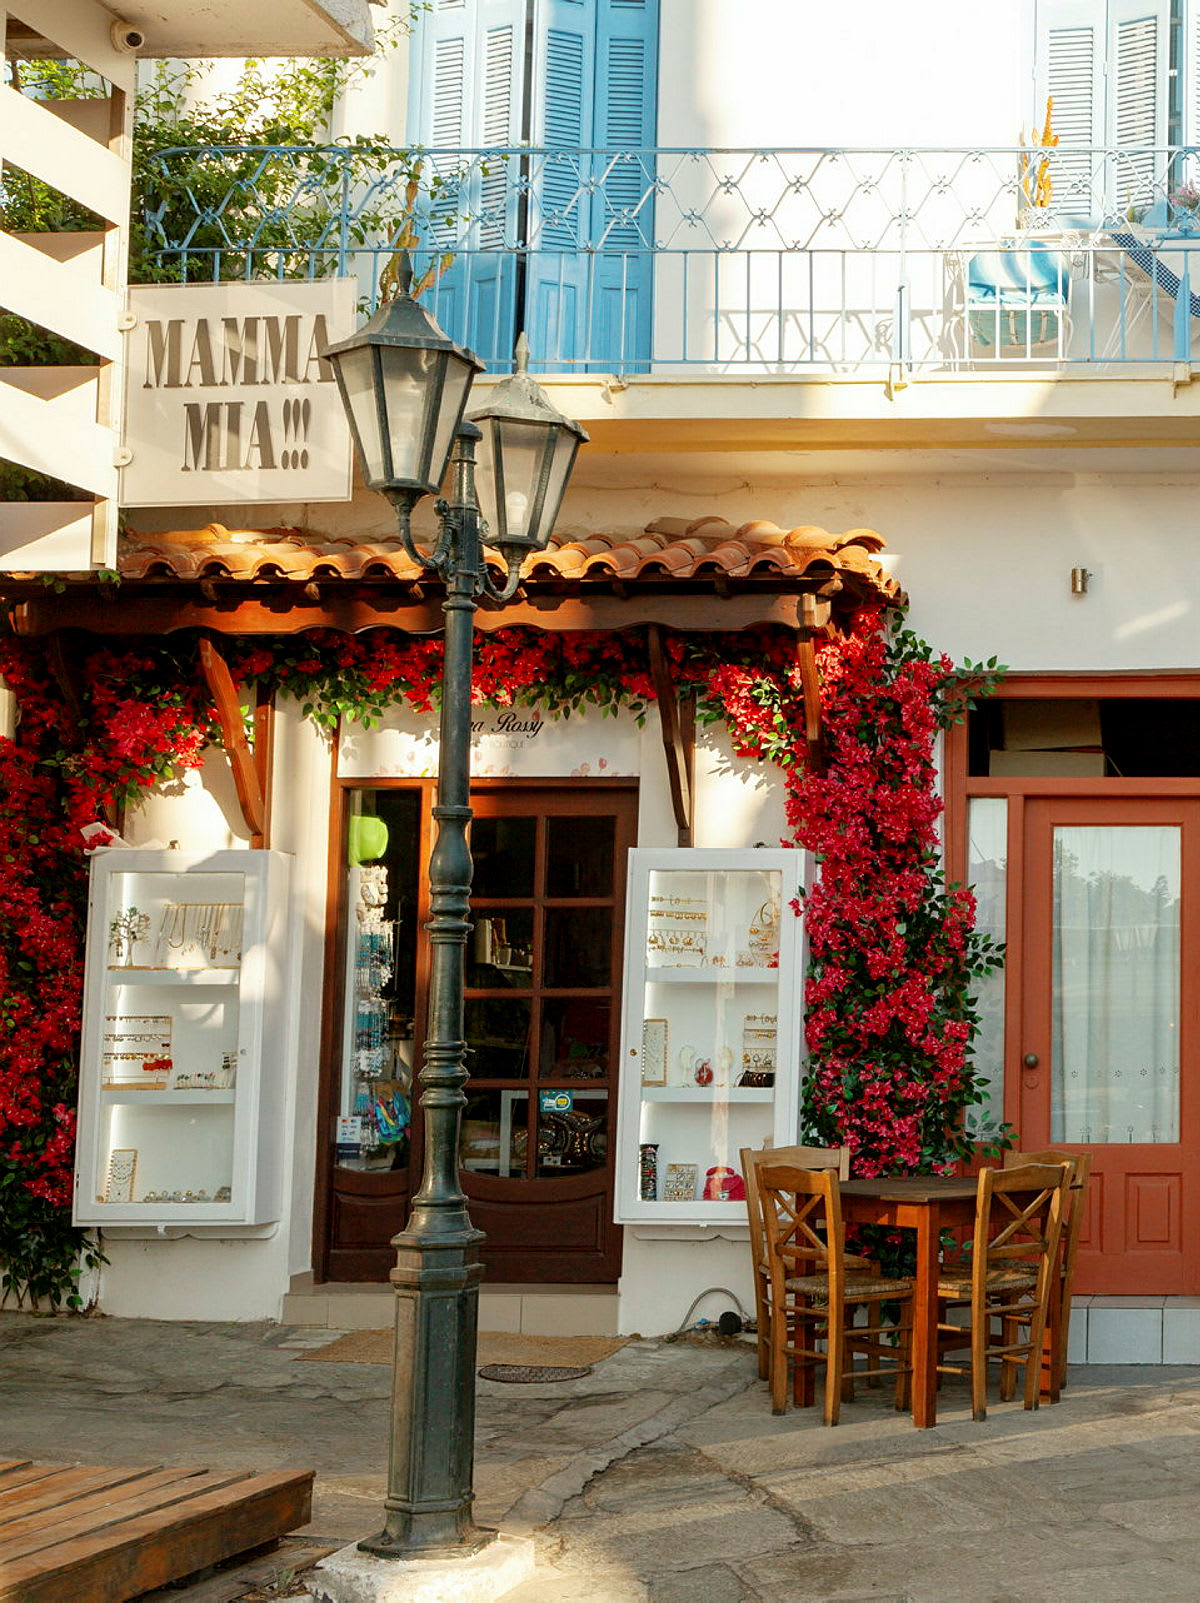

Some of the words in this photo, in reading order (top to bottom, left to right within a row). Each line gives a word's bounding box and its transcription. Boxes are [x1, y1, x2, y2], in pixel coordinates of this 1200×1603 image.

[143, 314, 336, 389] MAMMA
[180, 397, 312, 472] MIA!!!
[491, 711, 544, 738] Rossy
